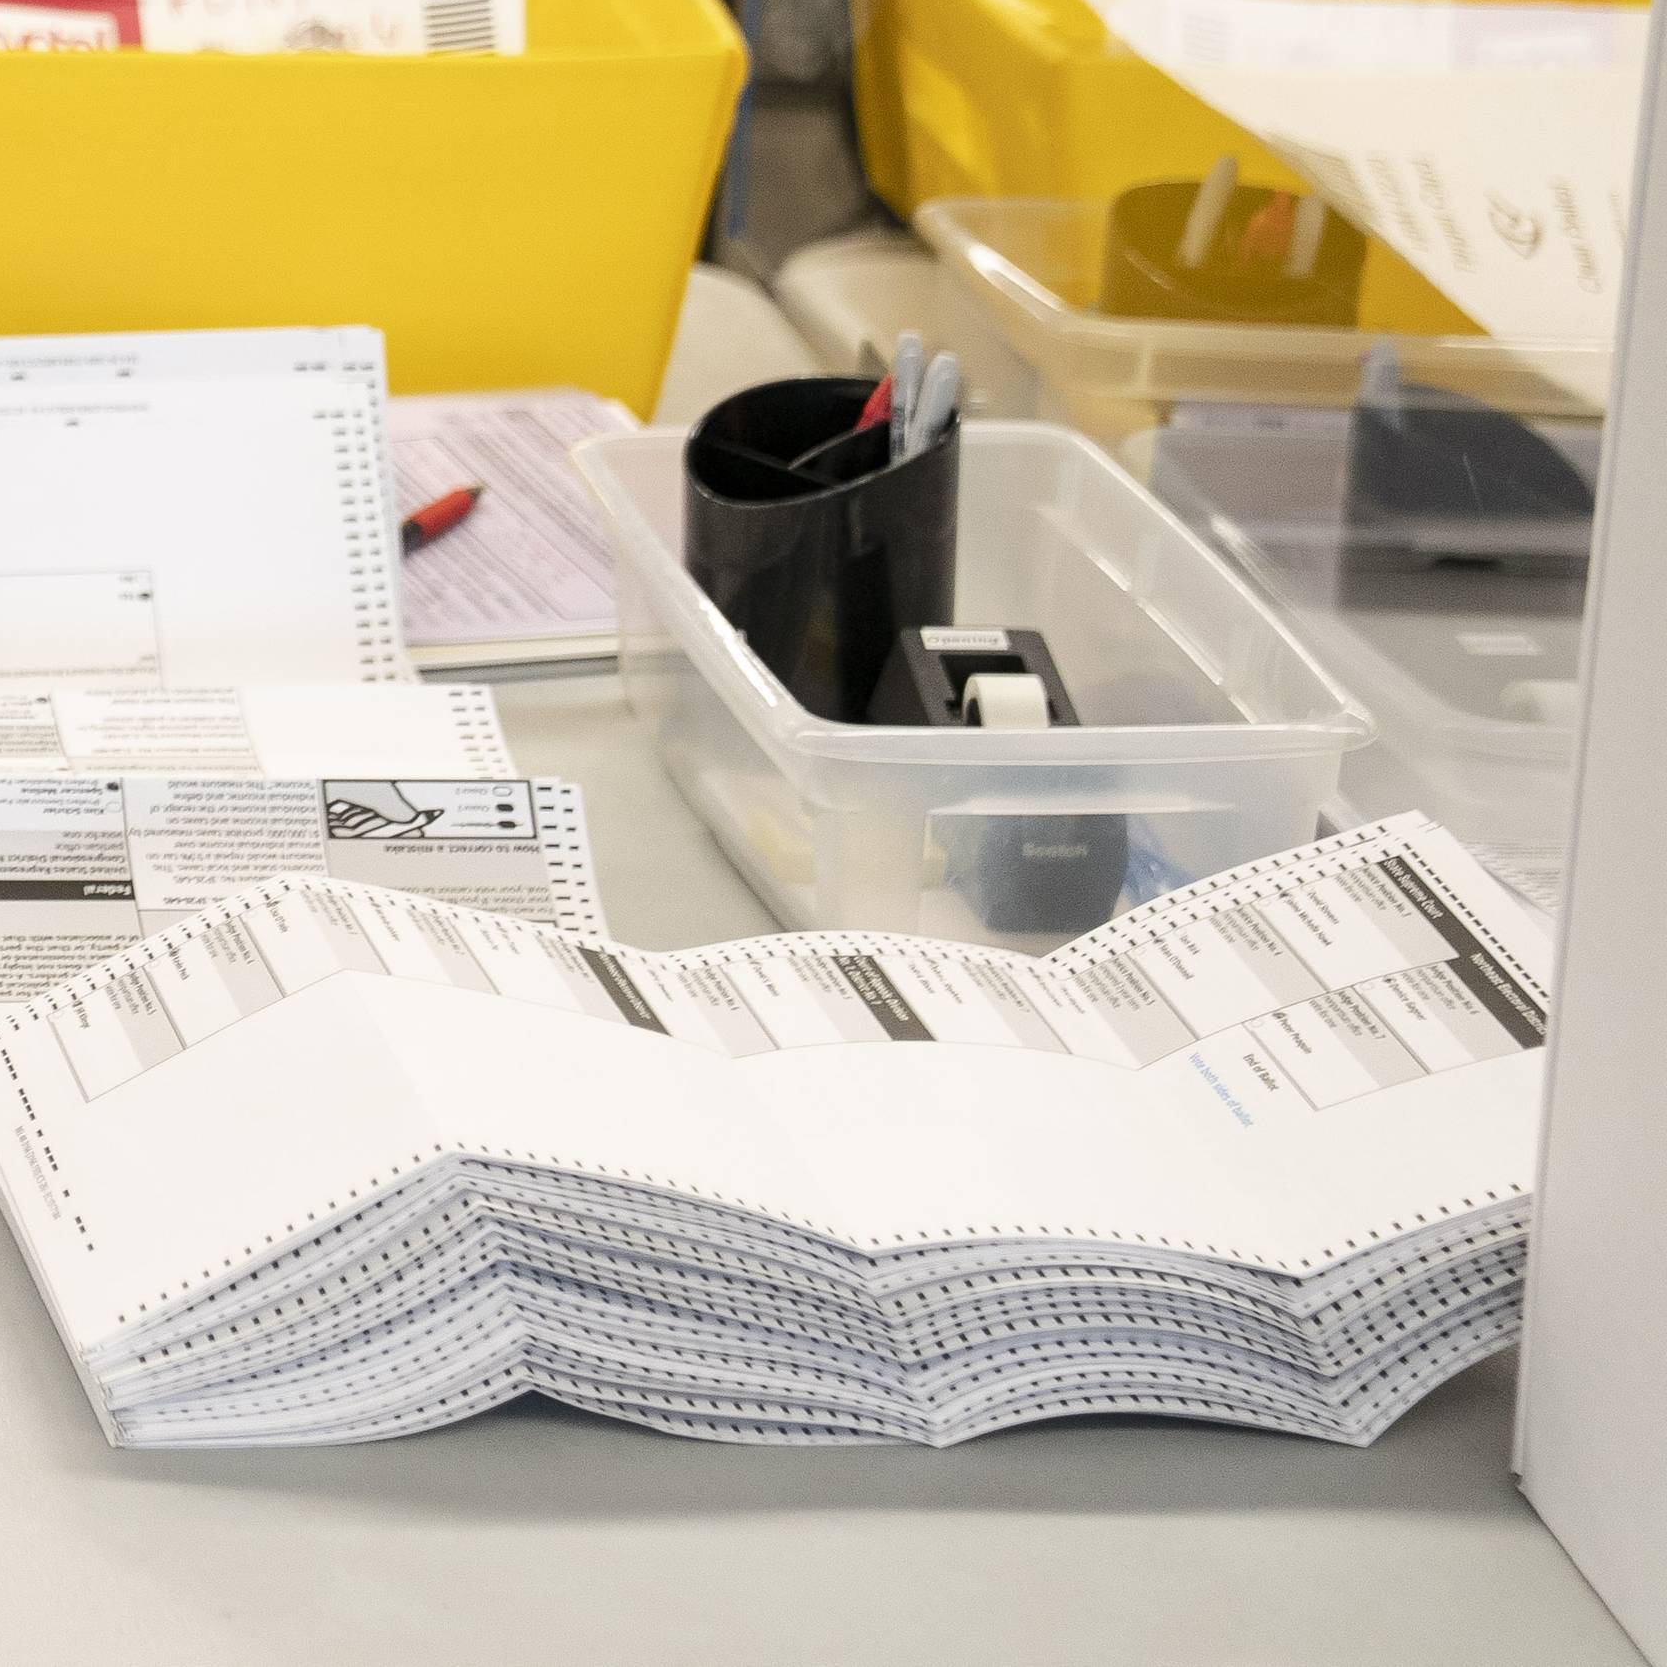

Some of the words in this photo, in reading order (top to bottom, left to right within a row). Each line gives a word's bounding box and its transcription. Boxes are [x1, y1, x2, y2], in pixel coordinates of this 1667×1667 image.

[382, 844, 434, 854] mistake
[447, 844, 492, 853] correct
[495, 845, 510, 853] to
[511, 844, 540, 853] How
[6, 853, 47, 864] District
[49, 851, 125, 865] Congressional
[52, 865, 88, 875] States
[89, 864, 127, 874] United
[1381, 857, 1408, 878] State
[81, 883, 132, 897] Federal
[1393, 872, 1431, 903] Supreme
[1418, 897, 1446, 920] Court
[1426, 964, 1448, 982] Judge
[1441, 979, 1467, 1002] Position
[1460, 999, 1475, 1011] No.
[1467, 951, 1506, 986] Northeast
[1495, 981, 1531, 1013] Electoral
[1520, 1008, 1552, 1037] Distric
[1332, 989, 1356, 1007] Judge
[1347, 1004, 1373, 1027] Position
[1366, 1024, 1381, 1036] No.
[1185, 1052, 1209, 1070] Vote
[1241, 1052, 1262, 1067] End
[1197, 1067, 1222, 1085] both
[1251, 1064, 1267, 1074] of
[1256, 1070, 1283, 1092] Ballot
[1210, 1082, 1234, 1101] sides
[1223, 1098, 1241, 1109] of
[1229, 1105, 1258, 1129] ballot
